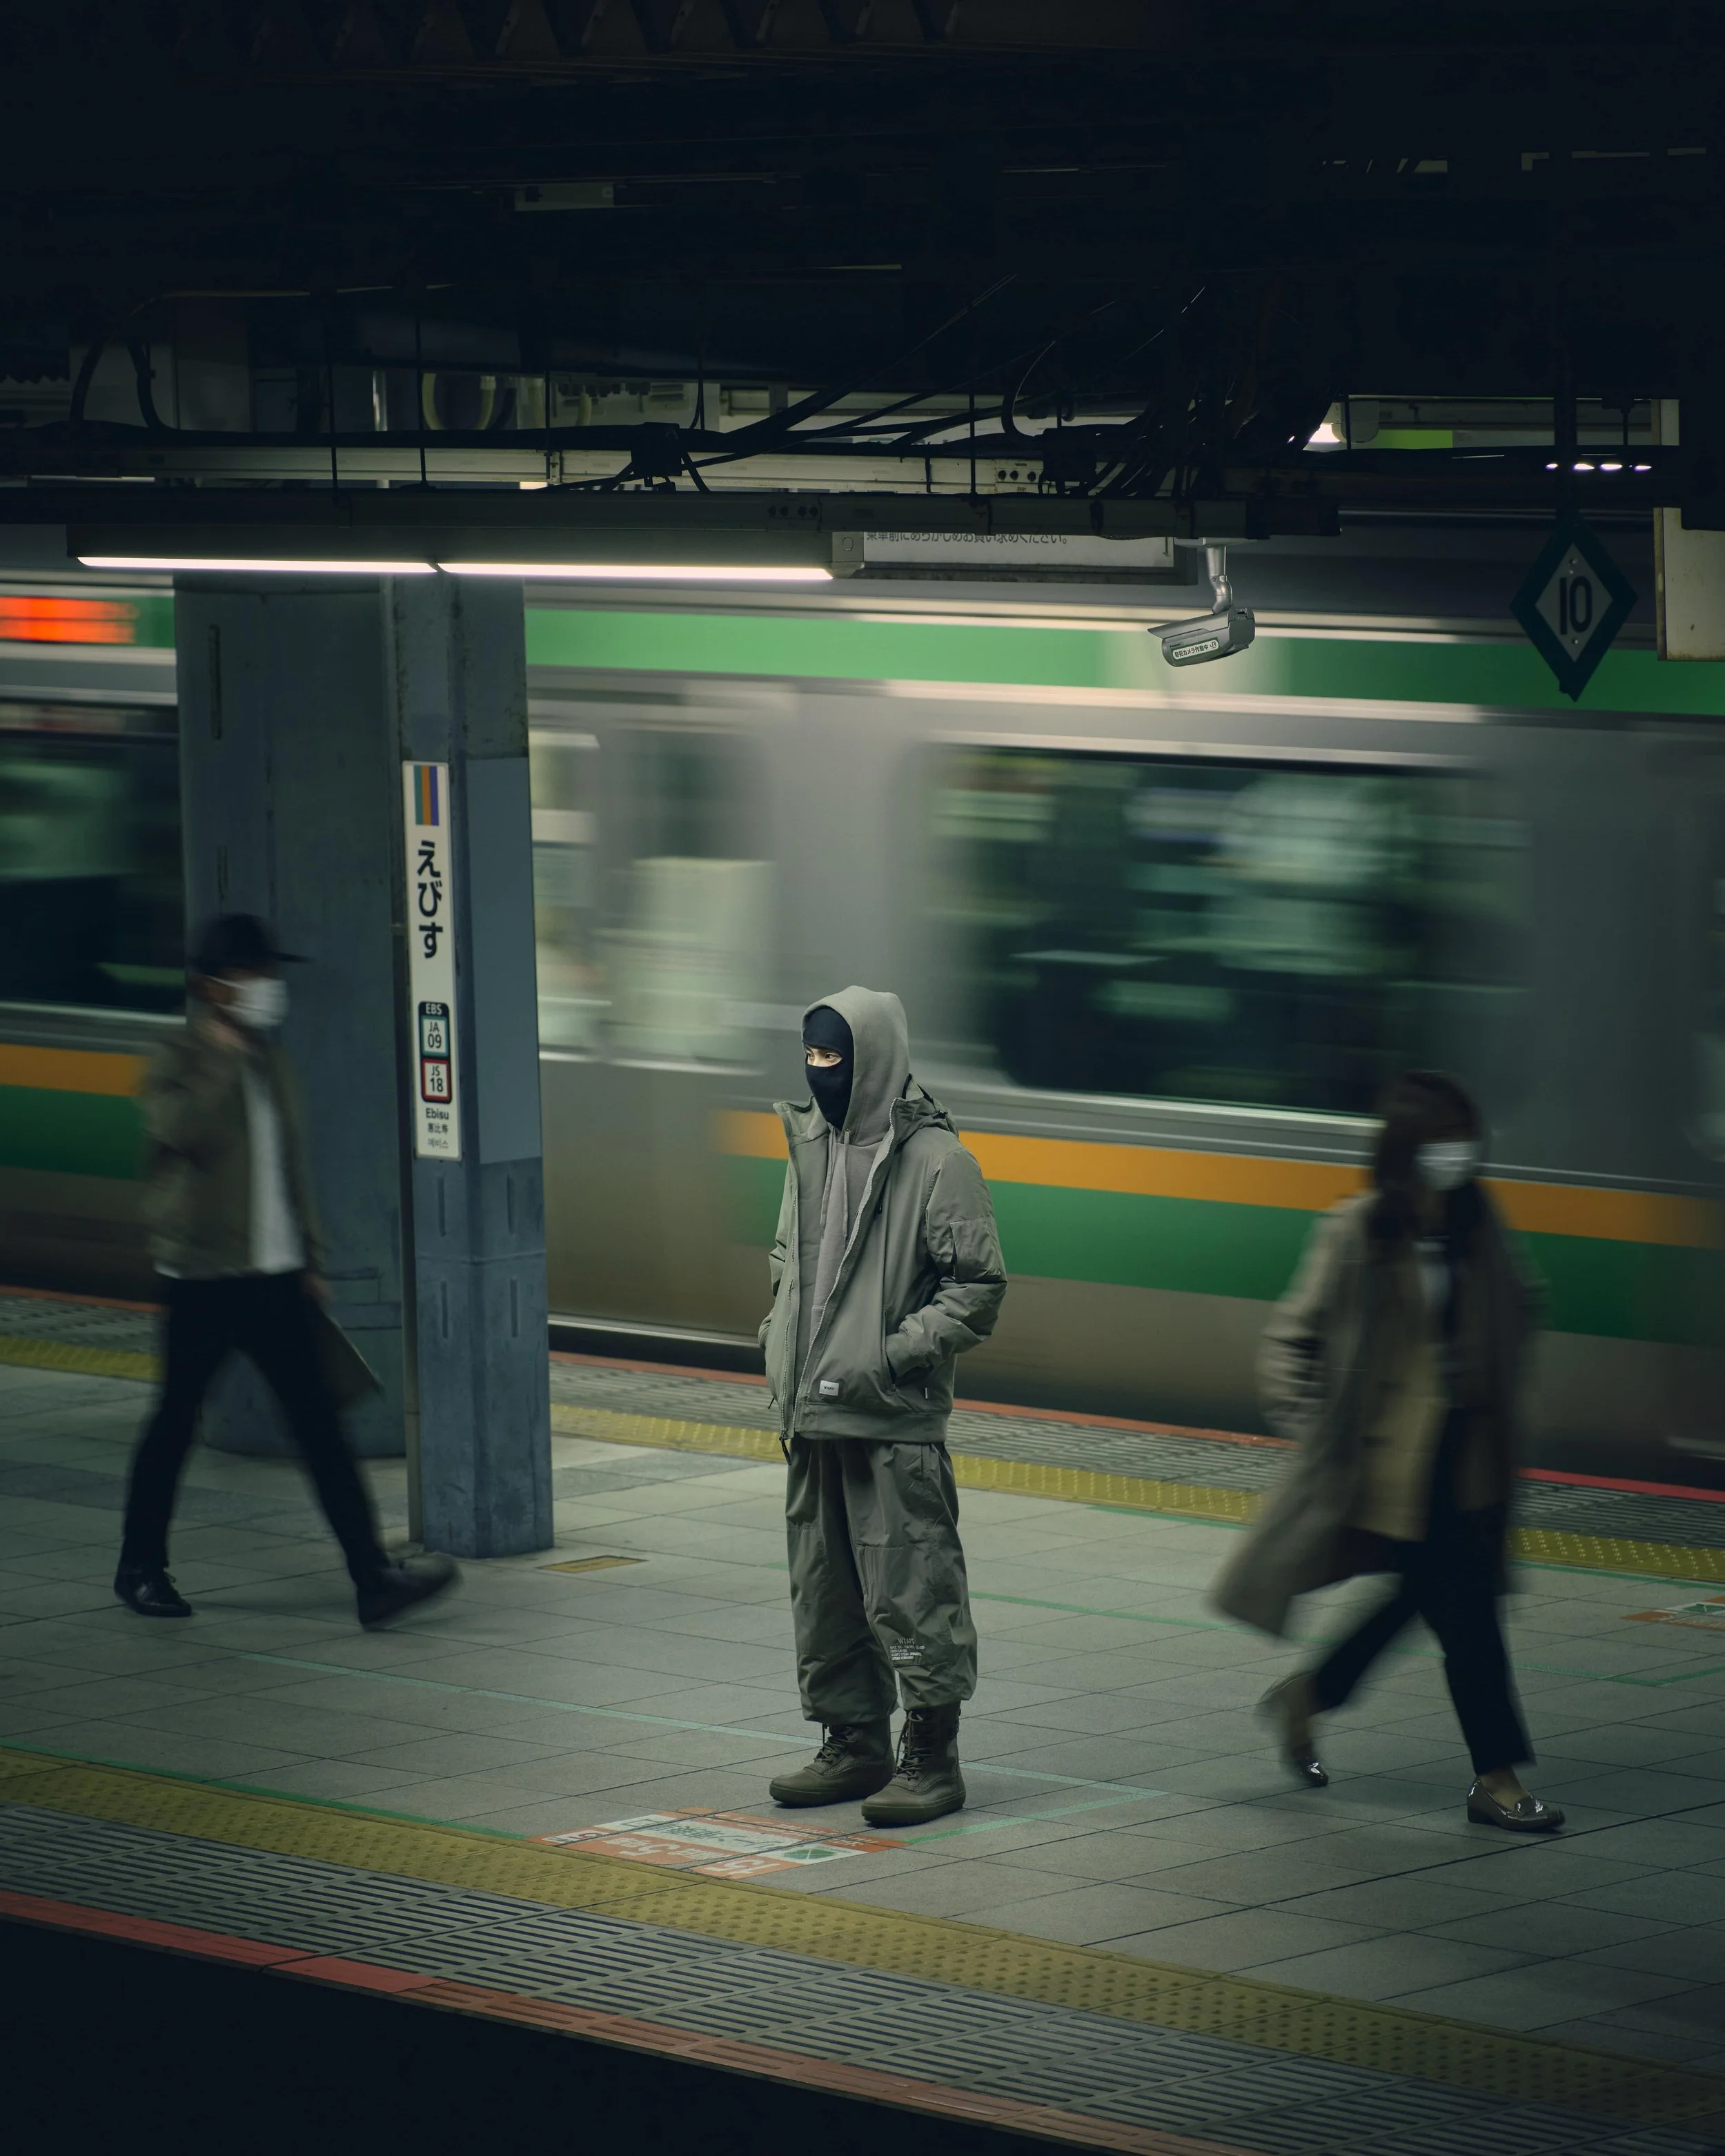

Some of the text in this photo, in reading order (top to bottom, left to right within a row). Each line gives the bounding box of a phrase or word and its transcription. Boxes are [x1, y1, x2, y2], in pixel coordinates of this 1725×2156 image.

[1559, 575, 1593, 635] 10
[1174, 644, 1209, 658] 防犯カメラ作動中
[417, 840, 443, 958] えびす
[425, 1002, 442, 1015] EBS
[429, 1022, 440, 1032] JA
[427, 1034, 442, 1049] 09
[431, 1066, 440, 1076] JS
[430, 1078, 444, 1093] 18
[425, 1107, 449, 1120] Ebisu
